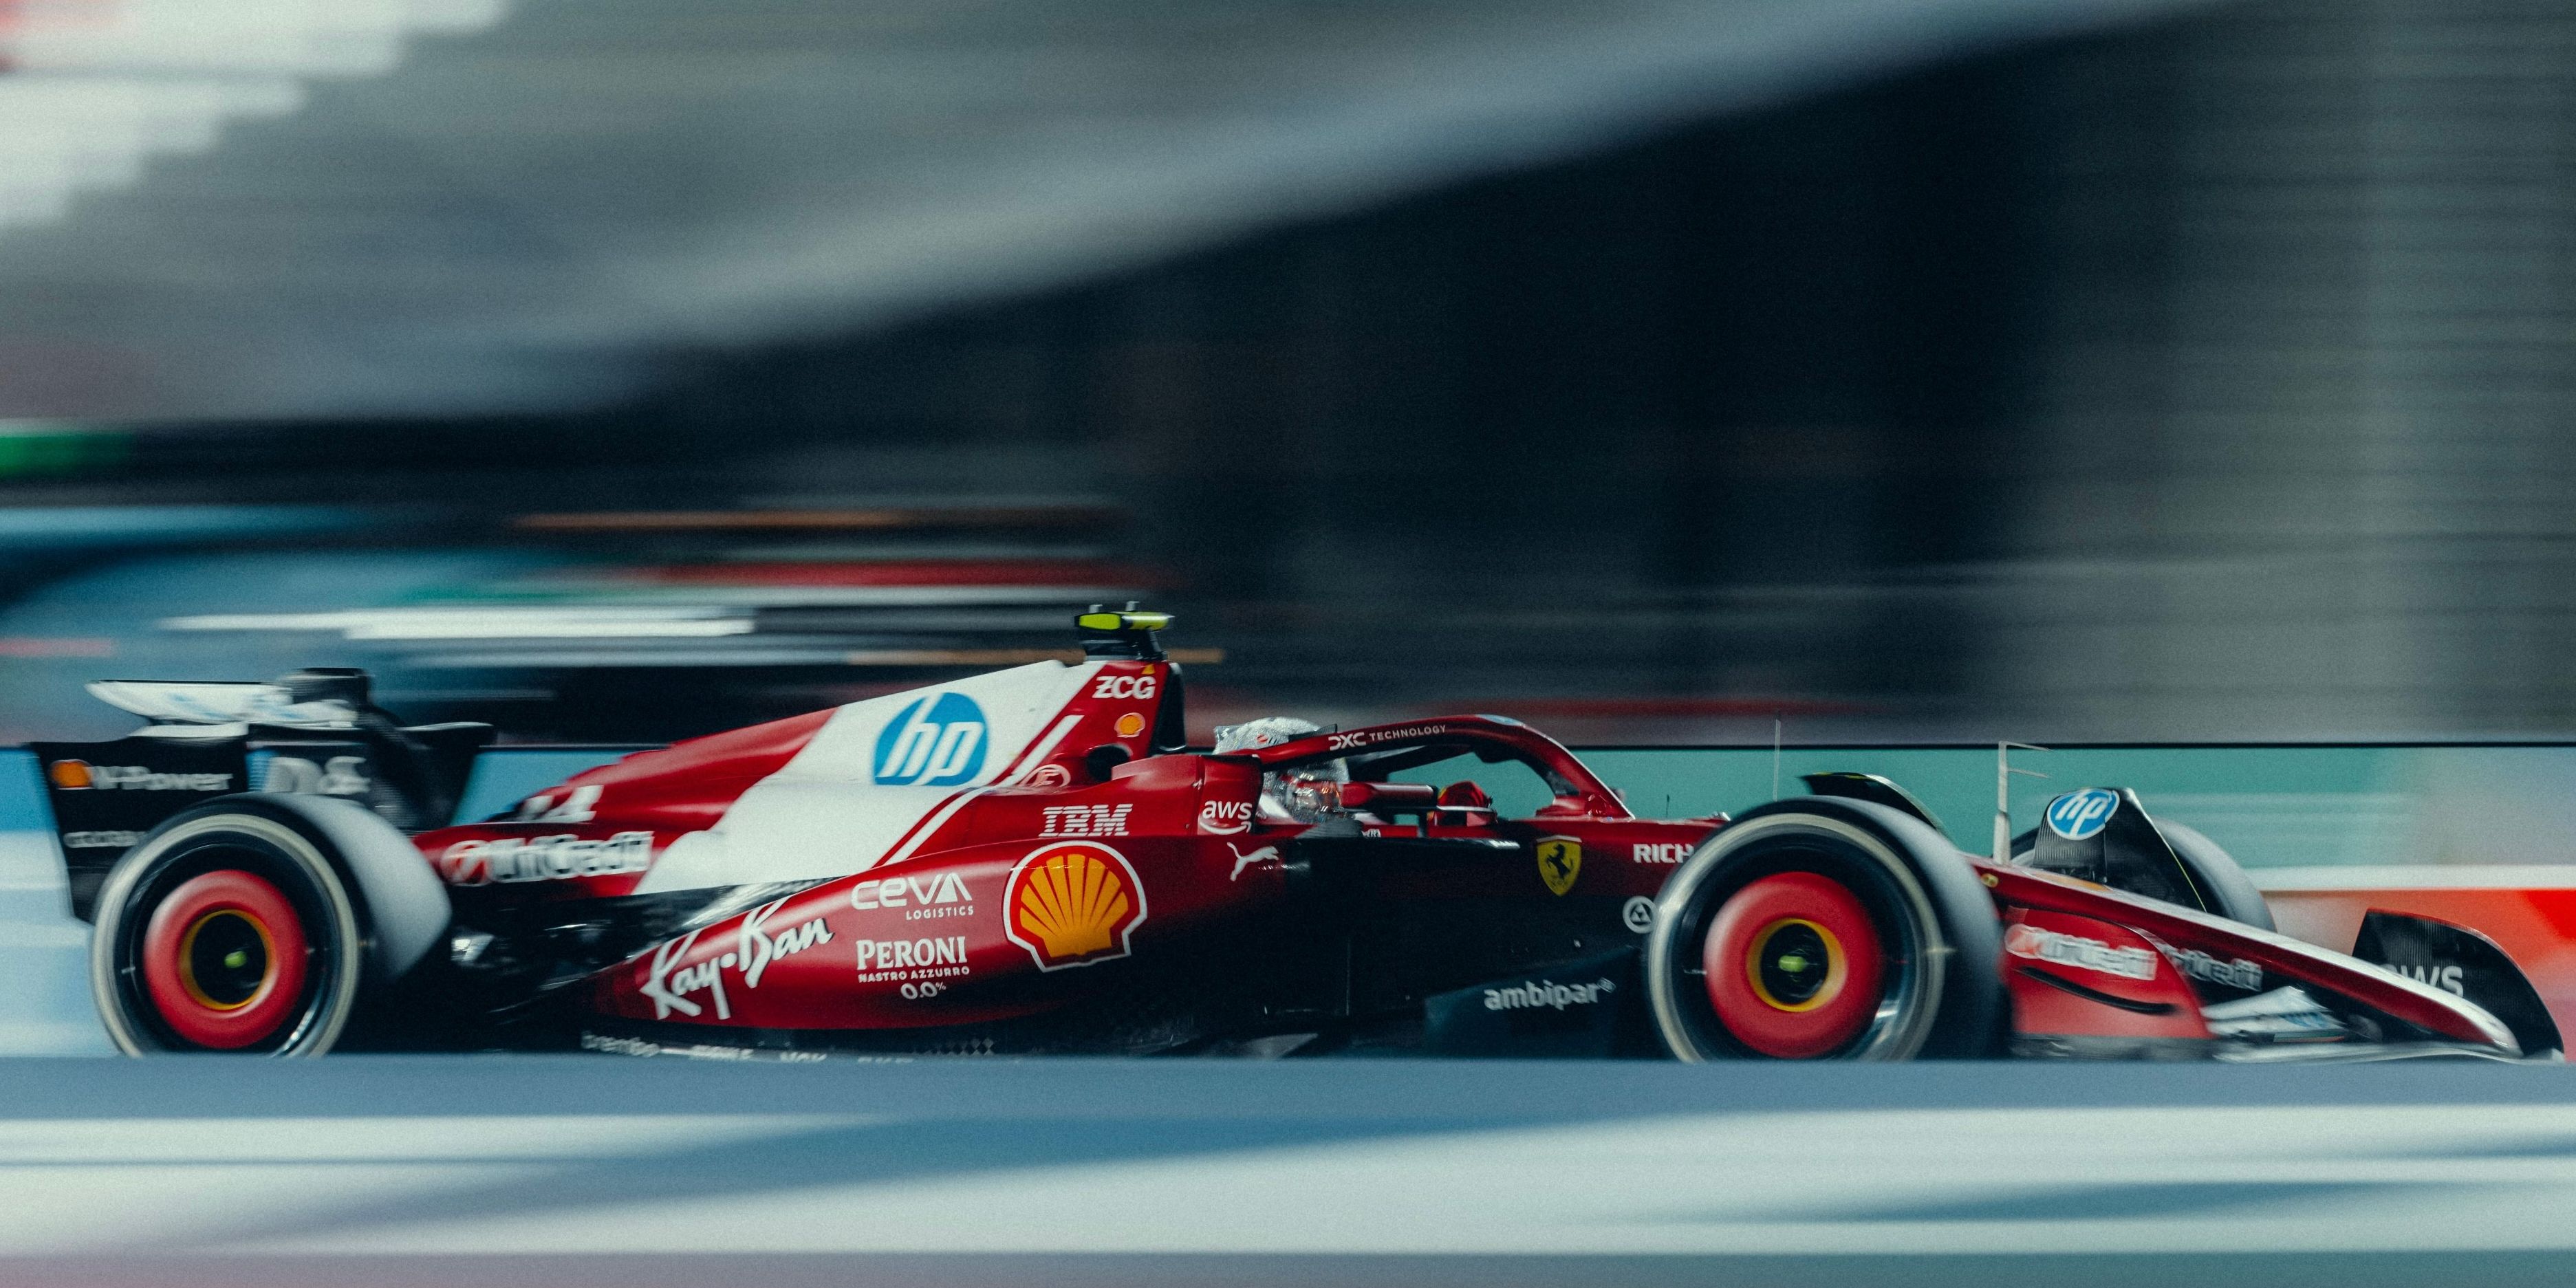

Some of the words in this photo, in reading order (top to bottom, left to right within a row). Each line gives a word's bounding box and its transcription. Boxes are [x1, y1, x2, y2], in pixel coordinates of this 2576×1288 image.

[876, 690, 986, 786] hp
[1369, 724, 1447, 742] TECHNOLOGY
[1038, 803, 1134, 838] IBM
[1202, 800, 1253, 820] aws
[2055, 789, 2109, 838] hp
[905, 905, 975, 921] LOGISTICS
[855, 935, 968, 970] PERONI
[858, 970, 908, 983] NASTRO
[910, 965, 971, 980] AZZURRO
